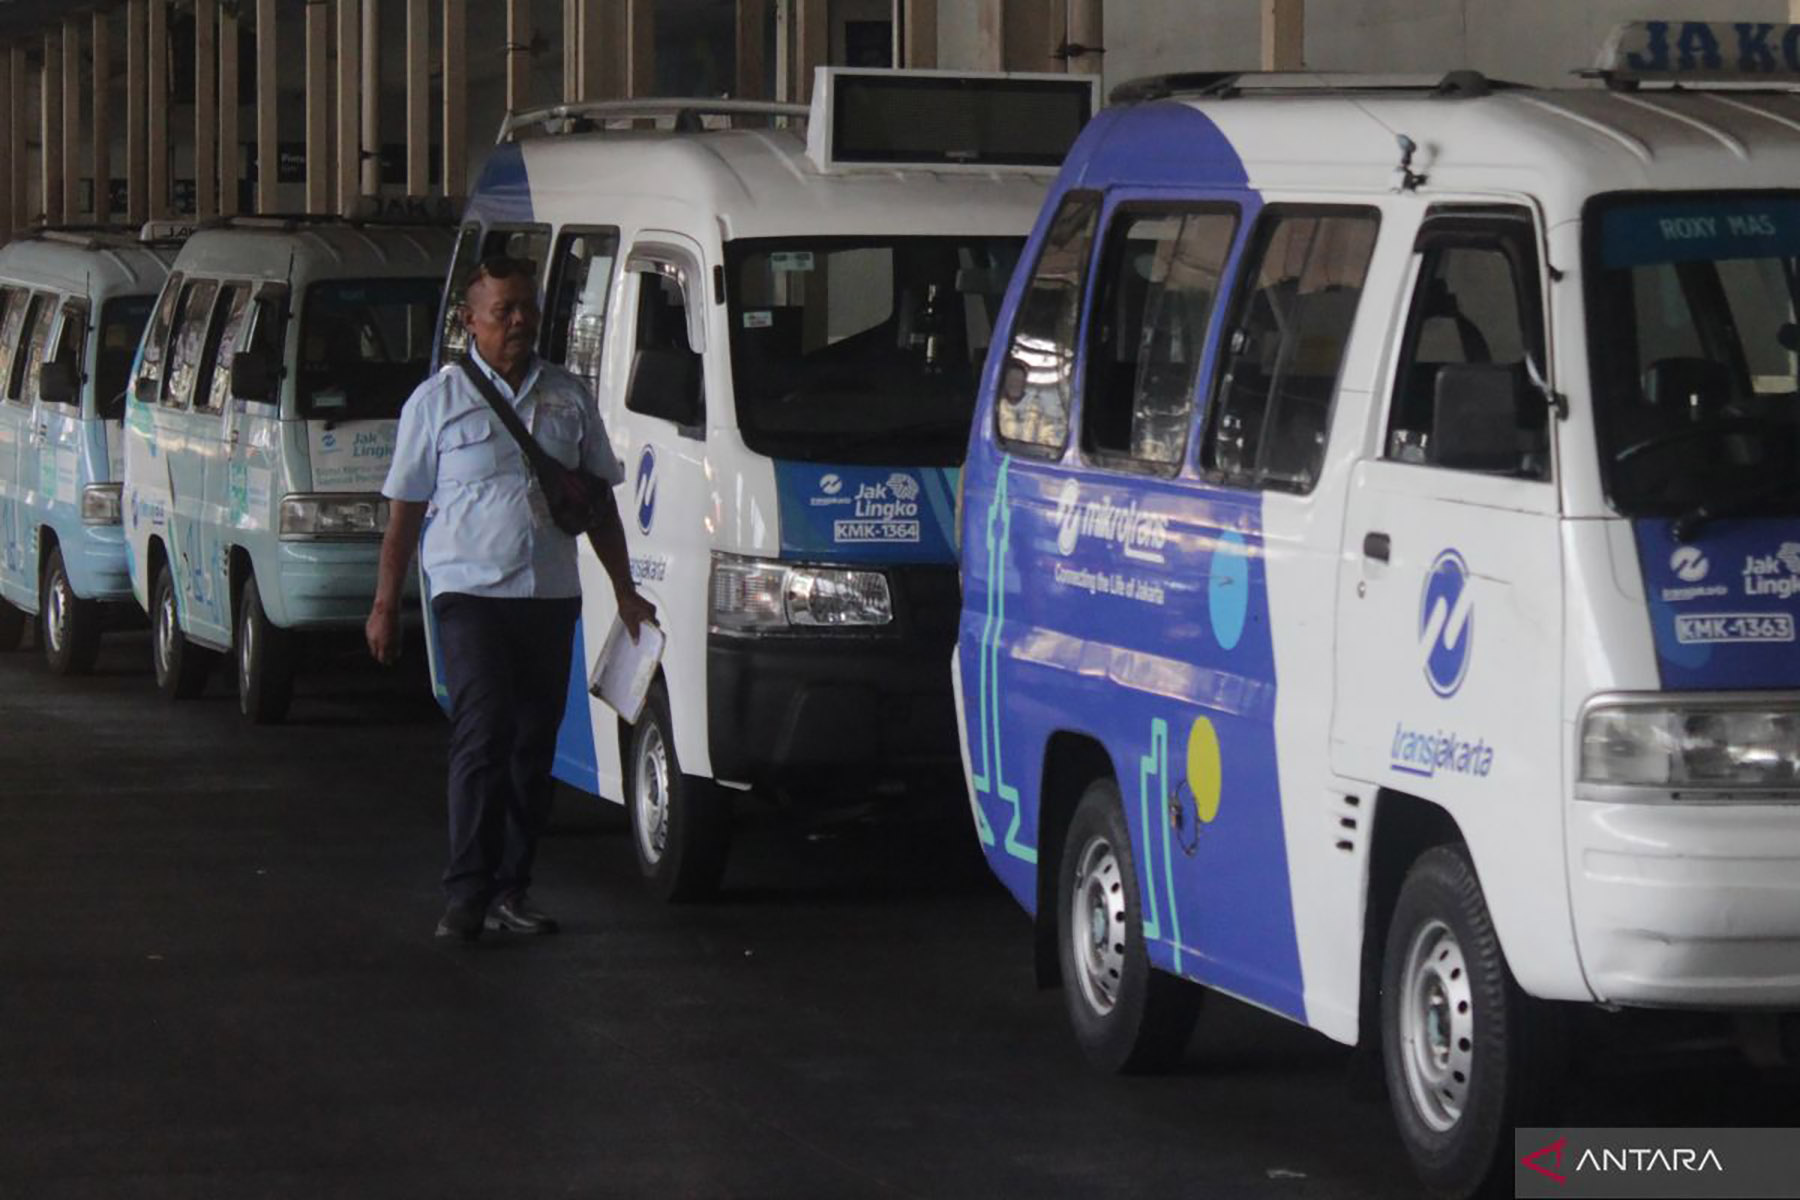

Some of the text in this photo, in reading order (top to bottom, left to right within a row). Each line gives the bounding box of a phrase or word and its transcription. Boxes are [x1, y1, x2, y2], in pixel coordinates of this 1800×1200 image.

[1659, 214, 1776, 240] ROXY MAS
[353, 432, 378, 445] Jak
[854, 483, 888, 500] Jak
[855, 500, 918, 522] Lingko
[836, 524, 917, 539] KMK-1364
[1742, 555, 1779, 576] Jak
[1680, 618, 1789, 638] KMK-1363
[1391, 721, 1494, 778] transjakarta
